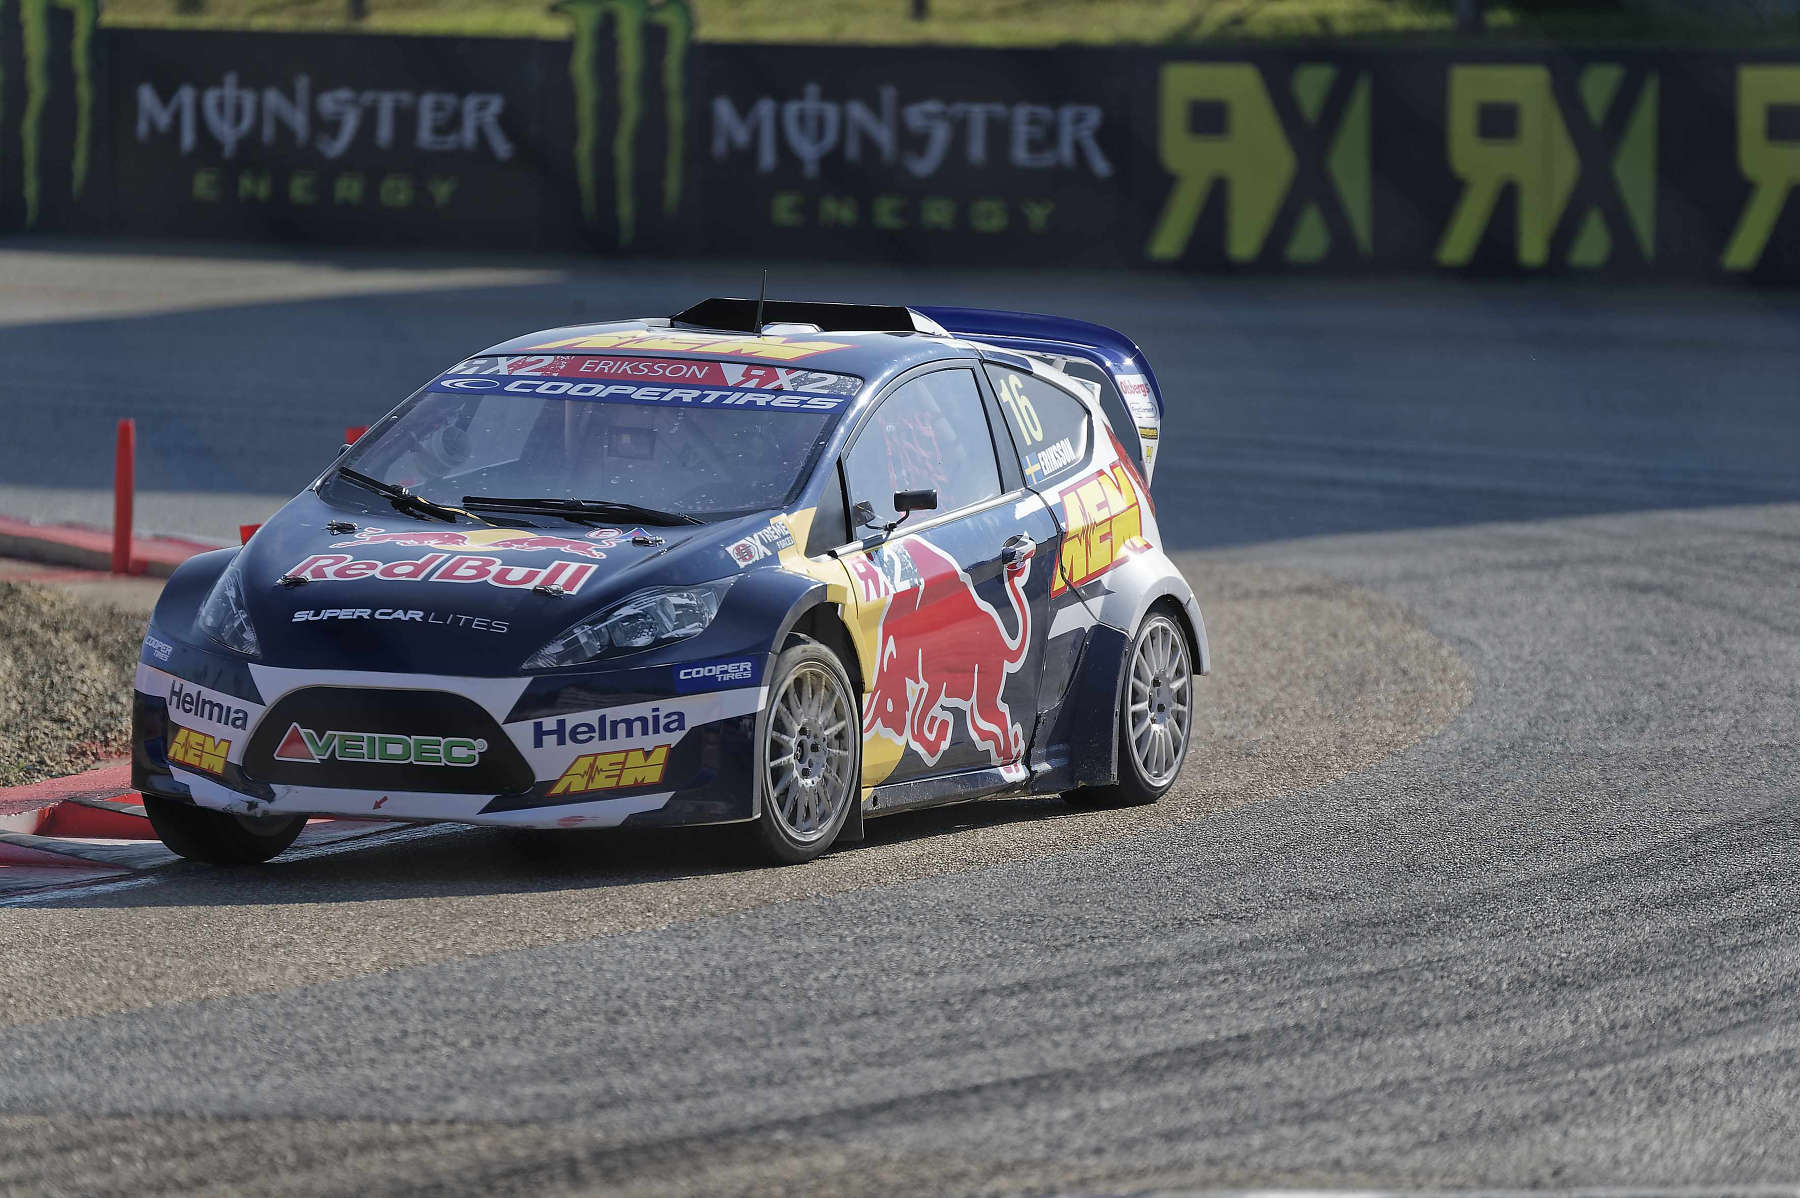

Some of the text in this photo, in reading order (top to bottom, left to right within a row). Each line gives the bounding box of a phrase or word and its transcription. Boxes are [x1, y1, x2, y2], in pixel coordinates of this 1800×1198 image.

[136, 72, 513, 161] MONSTER
[711, 82, 1112, 179] MONSTER
[193, 168, 458, 207] ENERGY
[771, 193, 1055, 231] ENERGY
[579, 358, 709, 379] ERIKSSON
[1001, 374, 1044, 446] 16
[1037, 437, 1076, 476] ERIKSSON
[278, 553, 599, 596] Red Bull
[292, 608, 510, 633] SUPER CAR LITES
[679, 661, 752, 680] COOPER
[715, 670, 752, 683] TIRES
[168, 679, 249, 732] Helmia
[533, 707, 687, 749] Helmia
[167, 727, 232, 776] AEM
[545, 744, 671, 797] AEM
